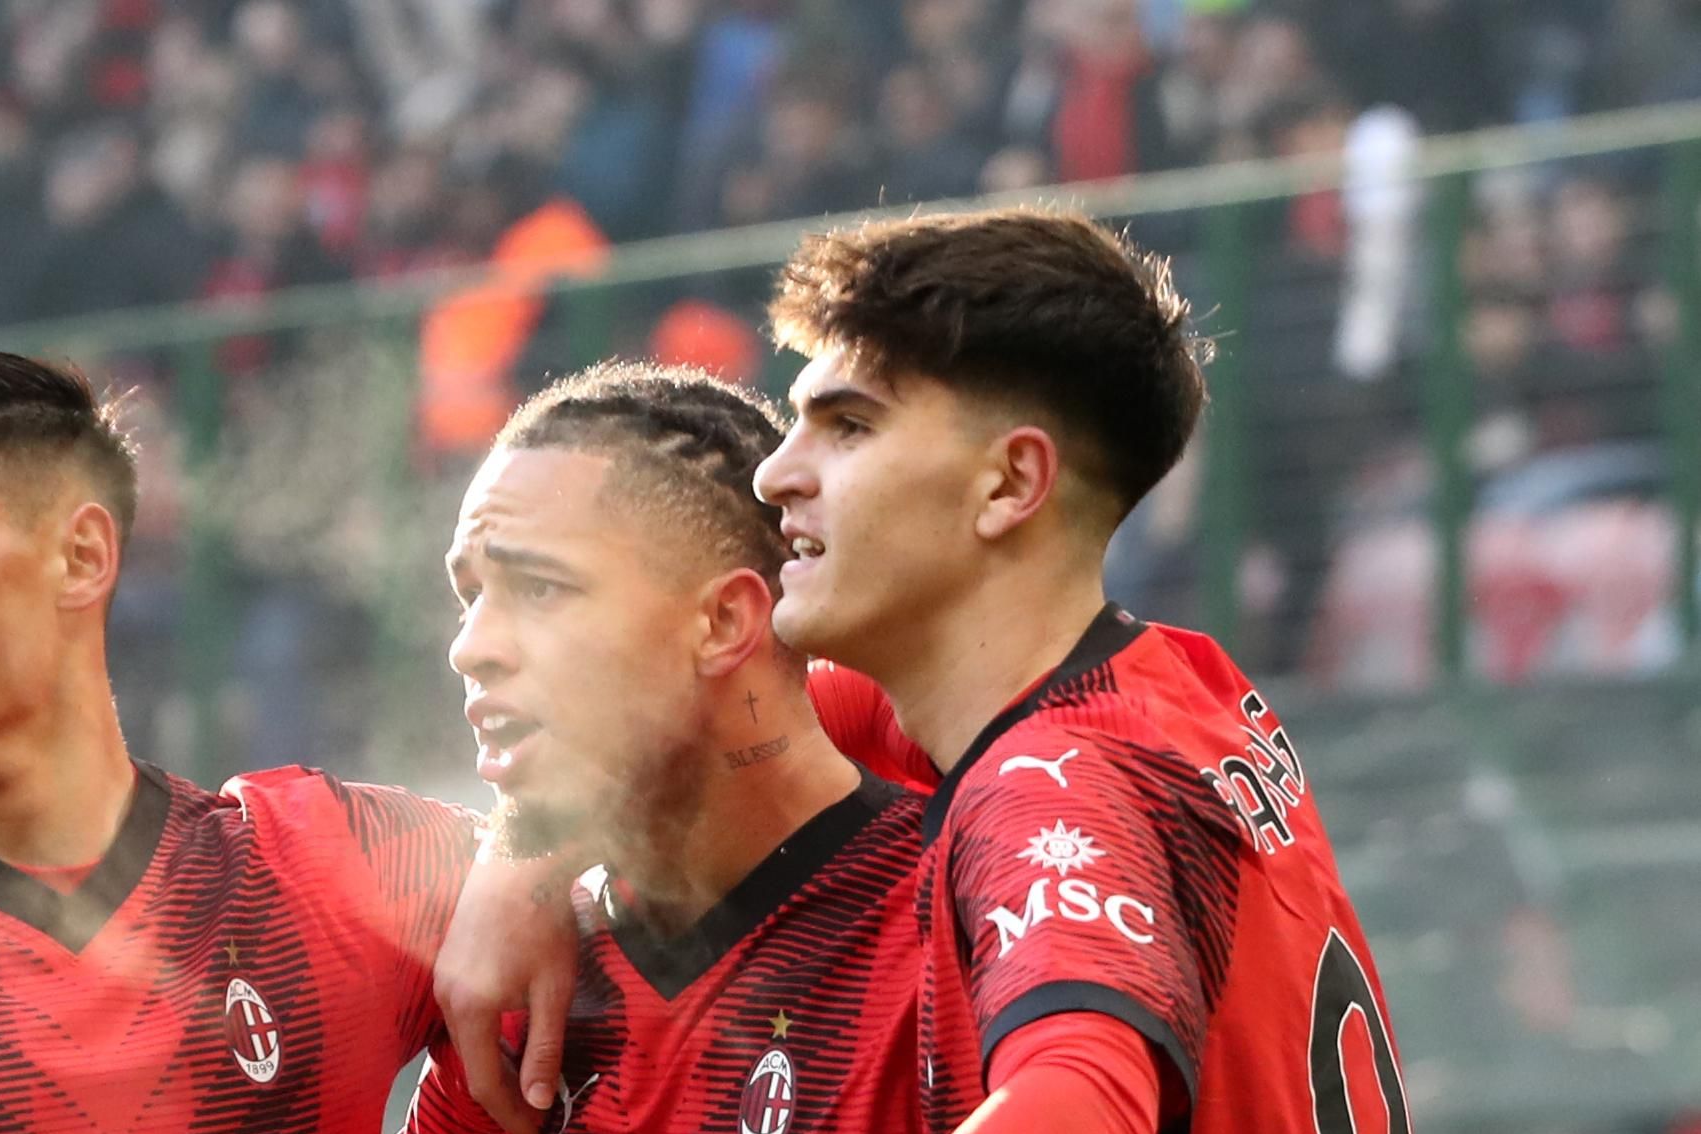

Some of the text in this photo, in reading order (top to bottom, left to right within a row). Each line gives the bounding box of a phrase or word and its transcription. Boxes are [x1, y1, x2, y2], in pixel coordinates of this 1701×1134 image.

[985, 877, 1155, 959] MSC
[246, 1060, 275, 1075] 1899
[759, 1053, 789, 1076] ACM
